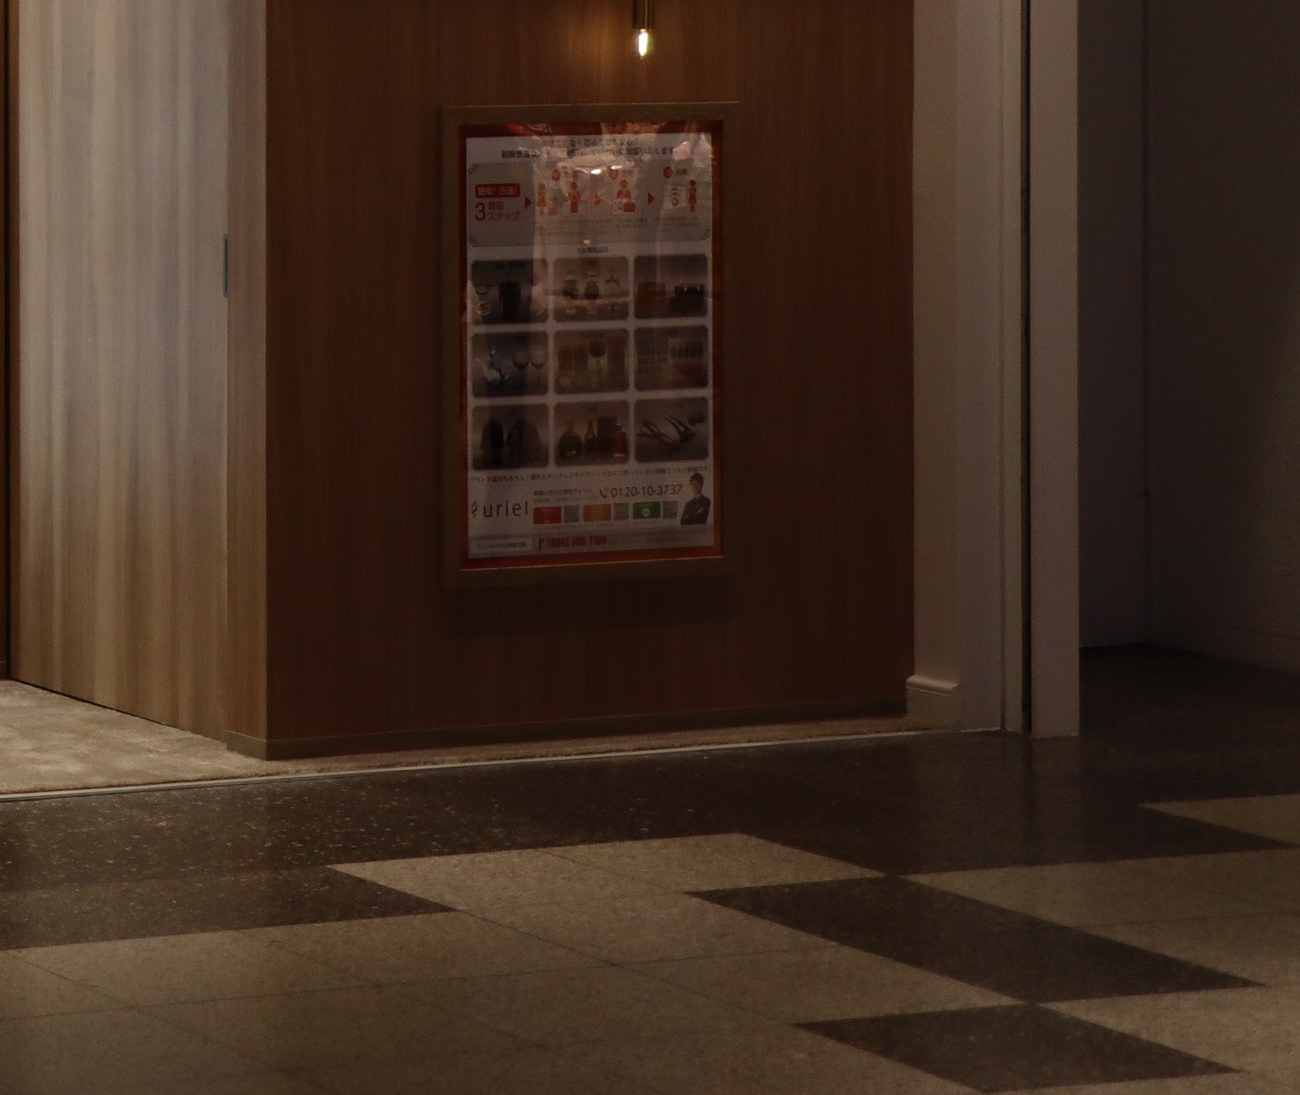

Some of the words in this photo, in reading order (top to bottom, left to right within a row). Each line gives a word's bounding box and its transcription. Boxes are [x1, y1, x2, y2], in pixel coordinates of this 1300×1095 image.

[475, 202, 487, 221] 3
[611, 484, 682, 498] 0120-10-3737
[483, 500, 528, 517] uriel
